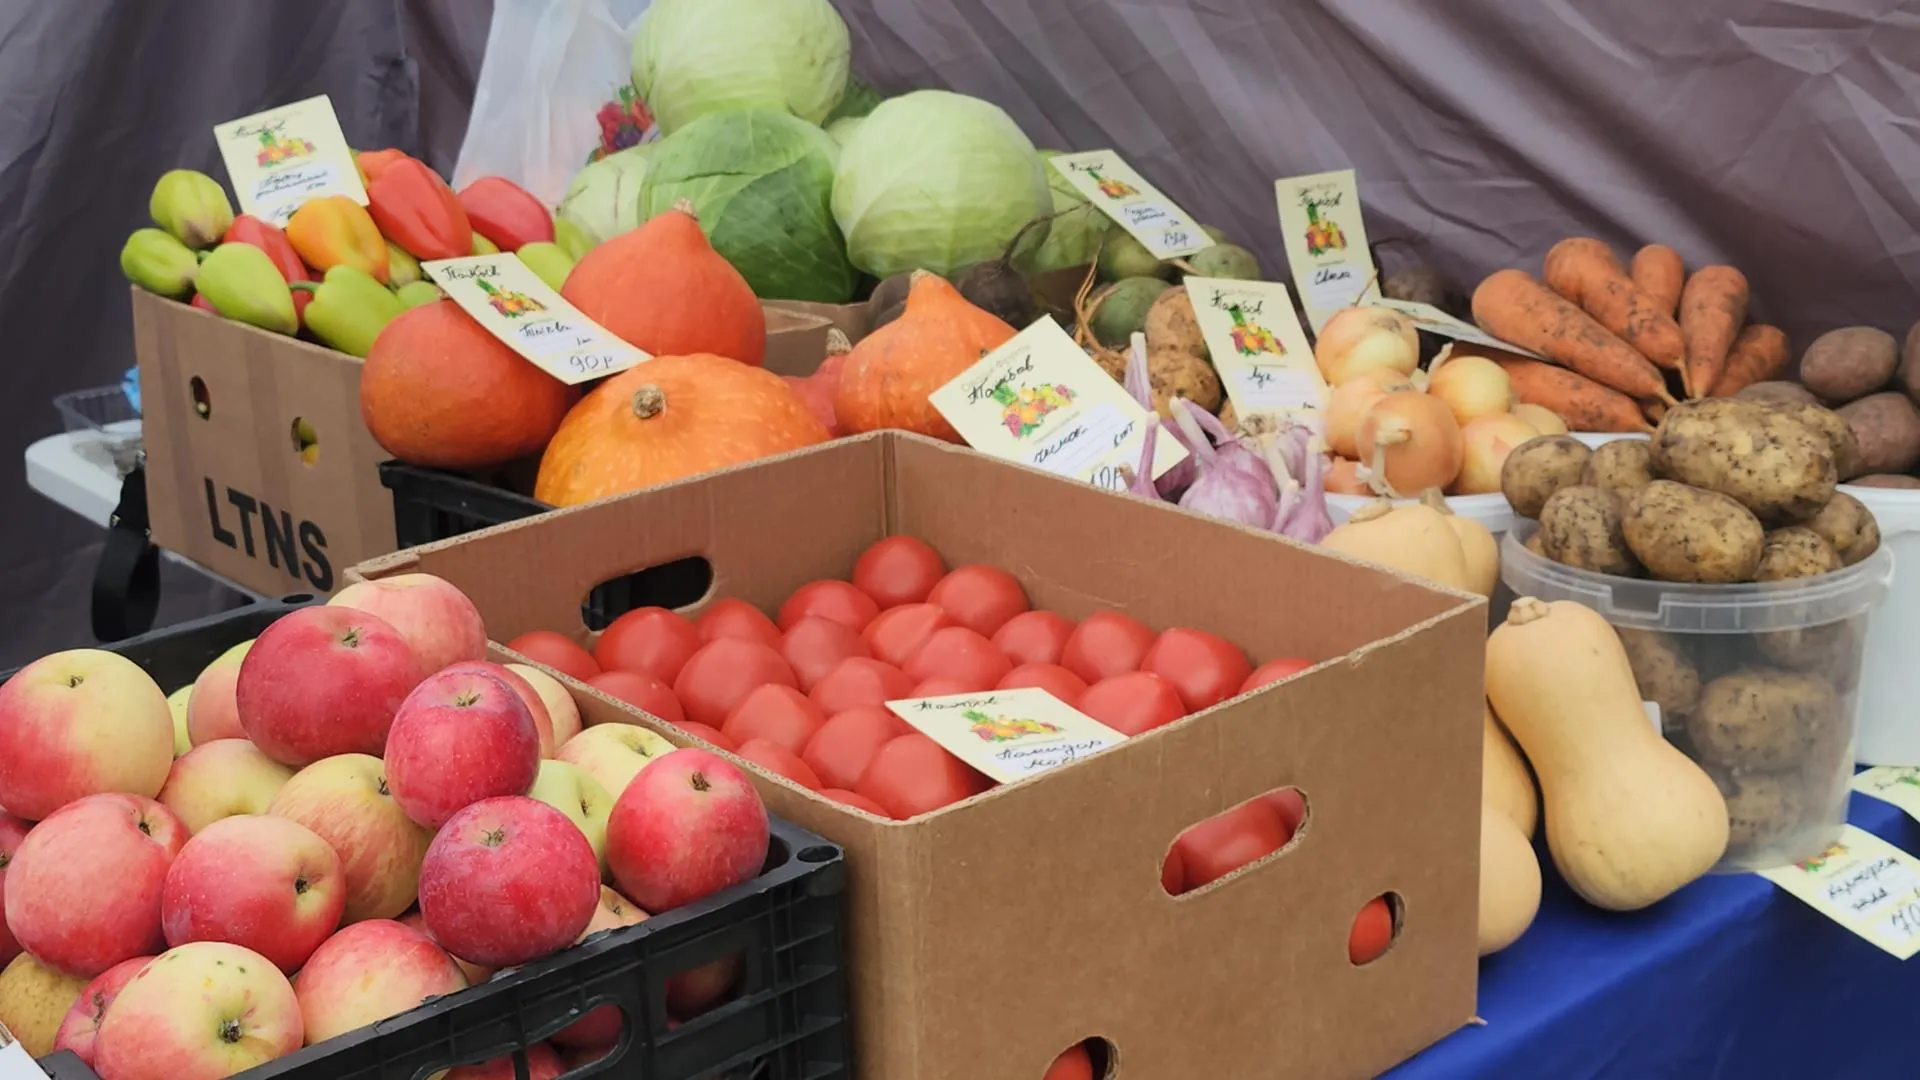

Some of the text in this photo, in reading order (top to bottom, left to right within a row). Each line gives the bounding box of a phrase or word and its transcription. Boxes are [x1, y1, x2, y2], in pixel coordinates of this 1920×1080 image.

[968, 354, 1036, 405] Тамбов
[205, 477, 333, 592] LTNS
[995, 740, 1103, 761] Помидор
